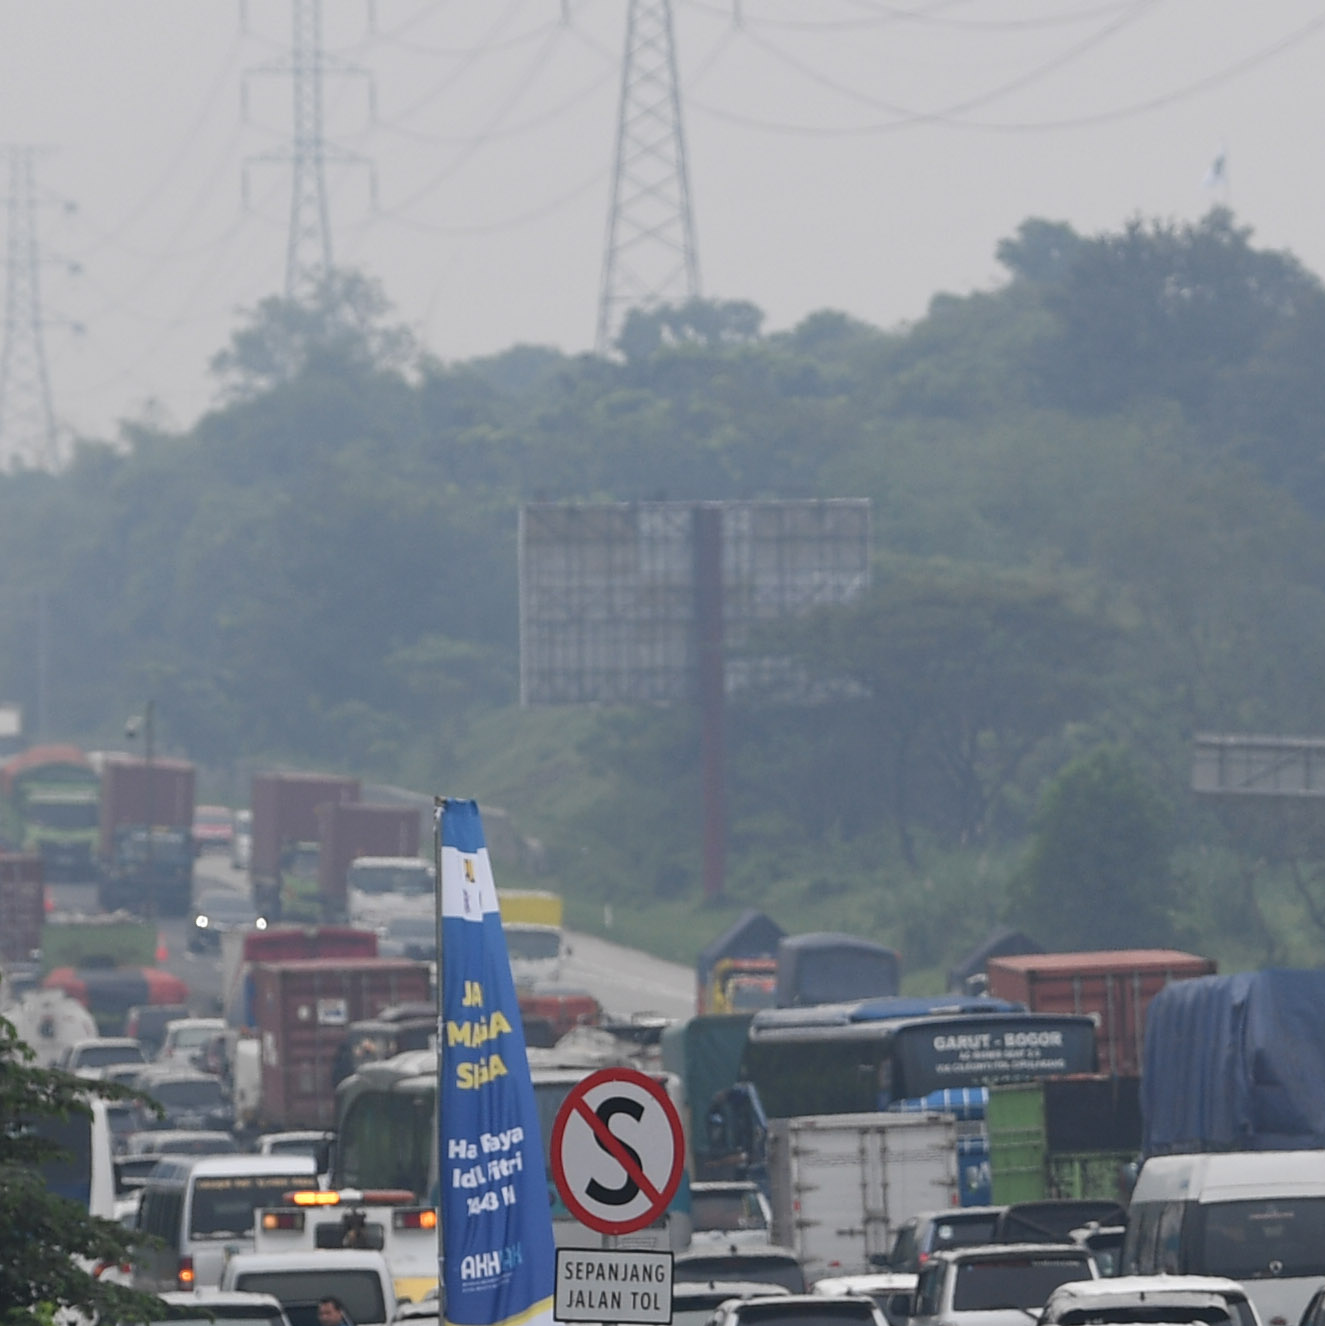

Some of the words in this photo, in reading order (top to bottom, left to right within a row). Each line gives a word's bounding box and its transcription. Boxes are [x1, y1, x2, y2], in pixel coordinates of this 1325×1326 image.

[933, 1033, 991, 1051] GARUT
[1003, 1031, 1063, 1048] BOGOR
[564, 1261, 665, 1283] SEPANJANG
[566, 1289, 622, 1310] JALAN
[631, 1292, 661, 1311] TOL
